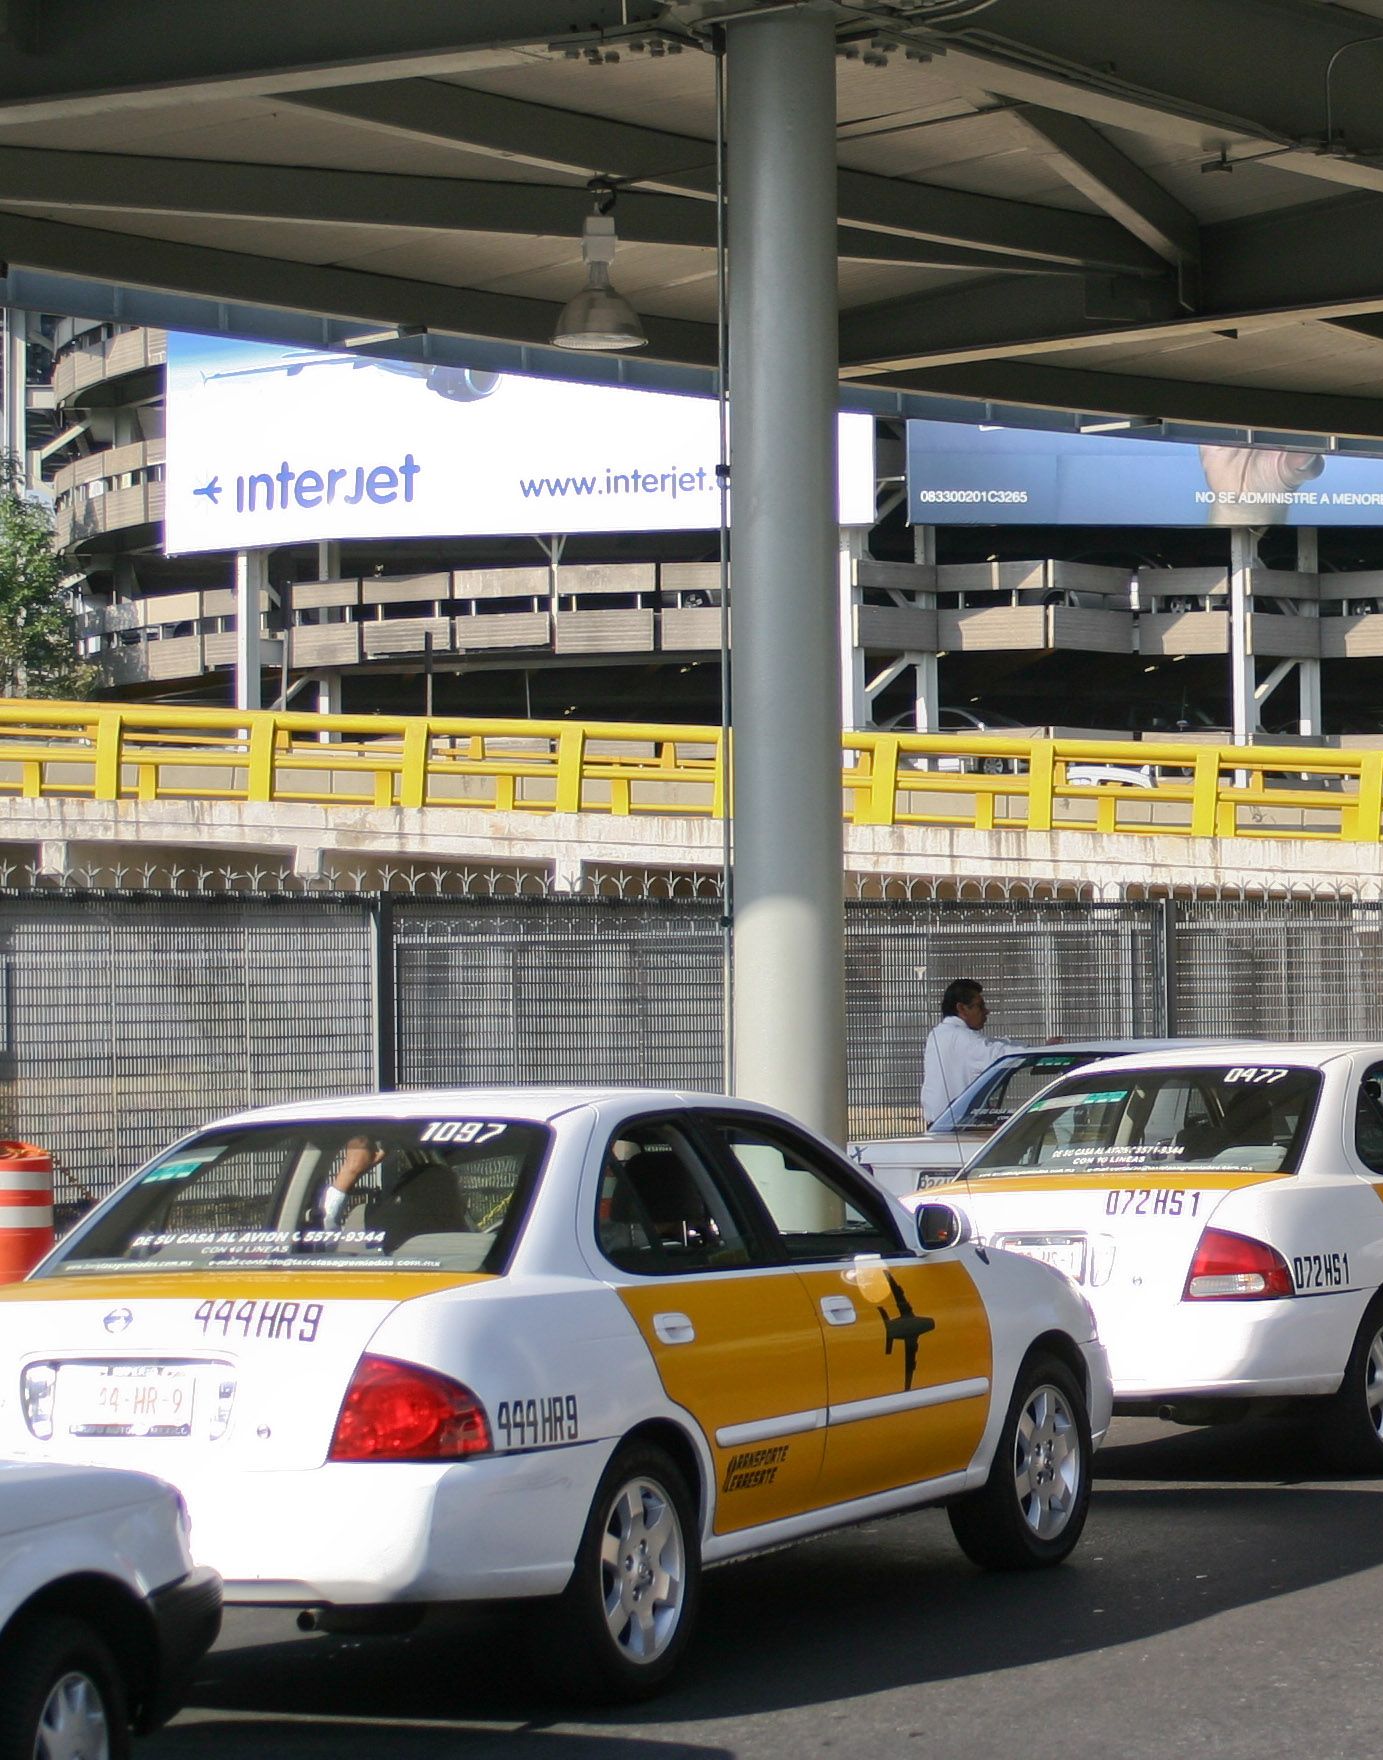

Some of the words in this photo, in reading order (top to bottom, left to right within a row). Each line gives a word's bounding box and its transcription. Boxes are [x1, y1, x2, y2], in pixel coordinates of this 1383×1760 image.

[236, 453, 421, 513] interjet
[519, 465, 731, 500] www.interjet.c
[920, 490, 1028, 503] 083300201C3265
[1195, 491, 1216, 504] NO
[1218, 491, 1236, 504] SE
[1238, 491, 1318, 505] ADMINISTRE
[1320, 493, 1331, 505] A
[1223, 1068, 1289, 1084] 0477
[420, 1121, 508, 1144] 1097
[1073, 1157, 1094, 1165] CON
[132, 1235, 152, 1247] DE
[154, 1234, 175, 1246] SU
[176, 1233, 215, 1244] CASA
[216, 1232, 237, 1243] AL
[239, 1231, 290, 1243] AVION
[303, 1231, 386, 1242] 5571-9344
[201, 1246, 228, 1254] CON
[244, 1246, 290, 1254] LINEAS
[1293, 1252, 1350, 1289] 072HS1
[194, 1300, 324, 1342] 444HR9
[497, 1394, 578, 1446] 444HR9
